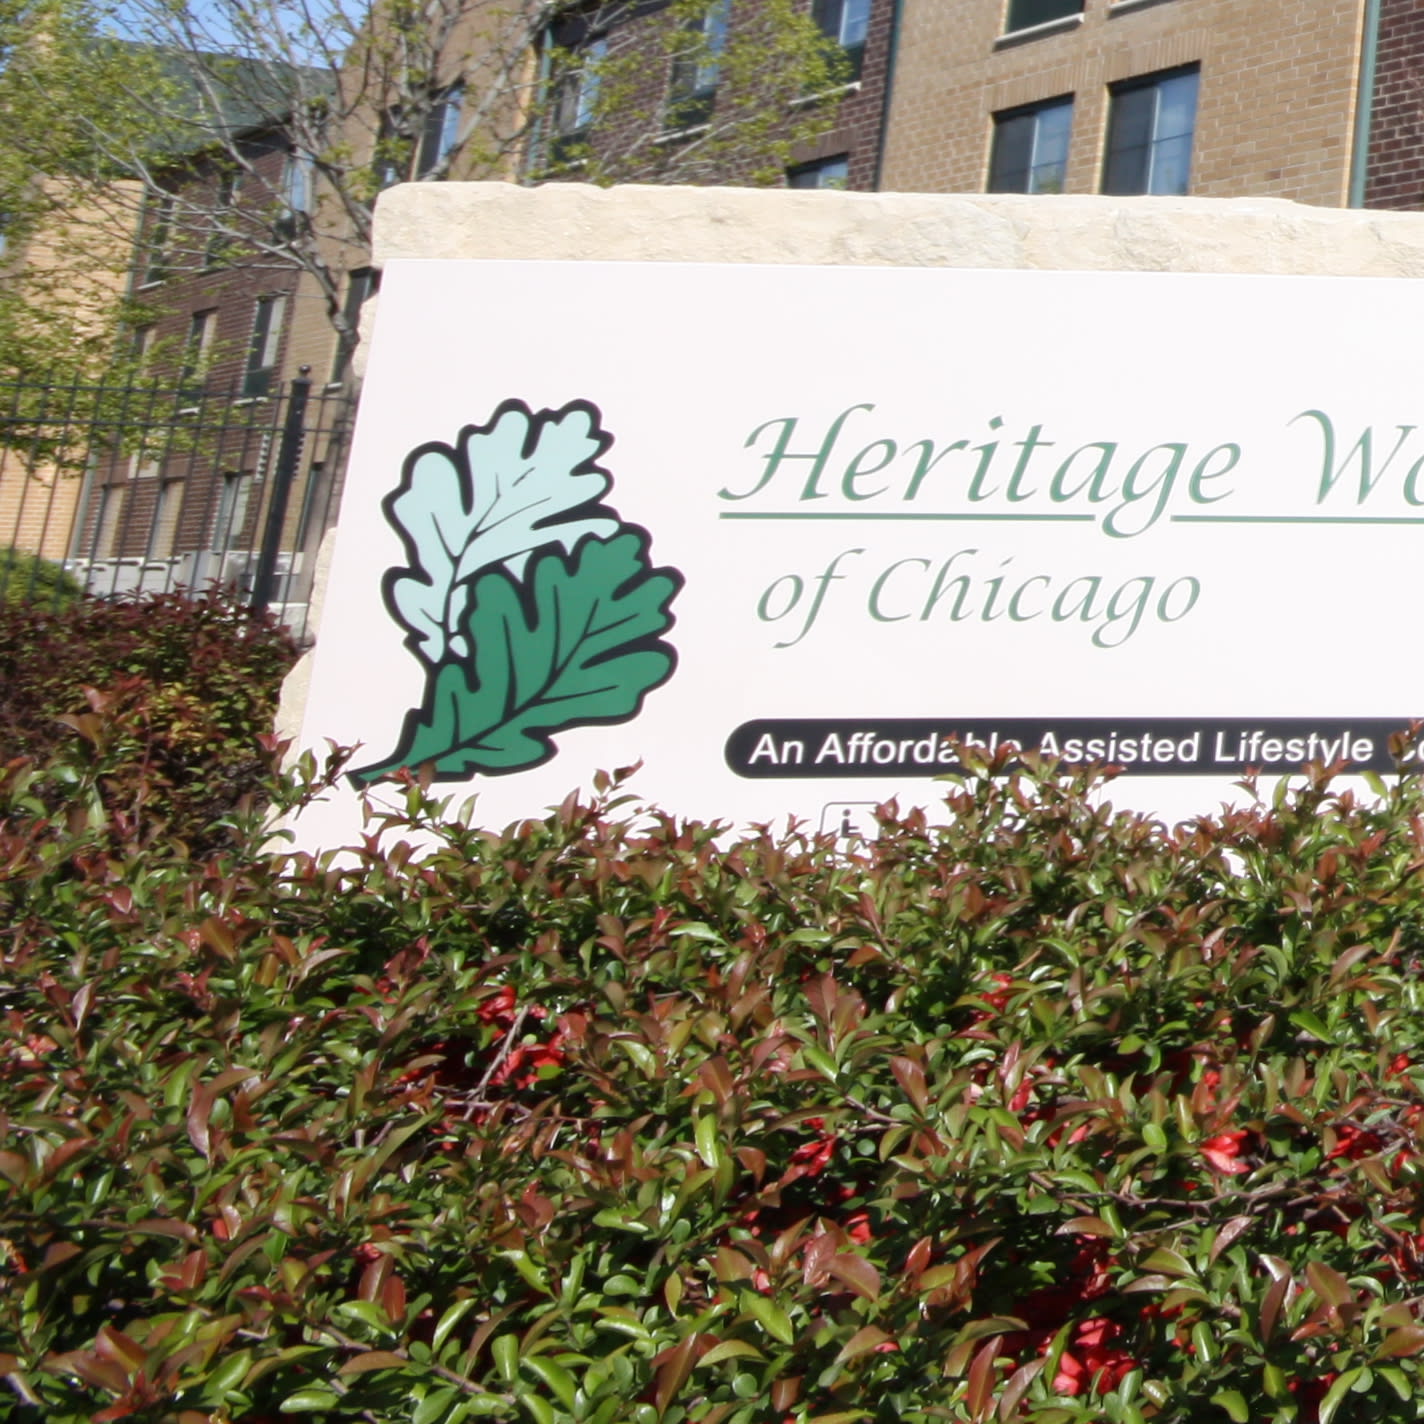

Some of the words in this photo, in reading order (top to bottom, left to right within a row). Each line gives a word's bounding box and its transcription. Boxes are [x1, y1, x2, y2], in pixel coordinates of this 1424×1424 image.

[717, 404, 1241, 539] Heritage
[757, 549, 867, 649] of
[867, 549, 1201, 649] Chicago
[748, 732, 804, 765] An
[1039, 731, 1200, 763] Assisted
[1214, 731, 1374, 768] Lifestyle
